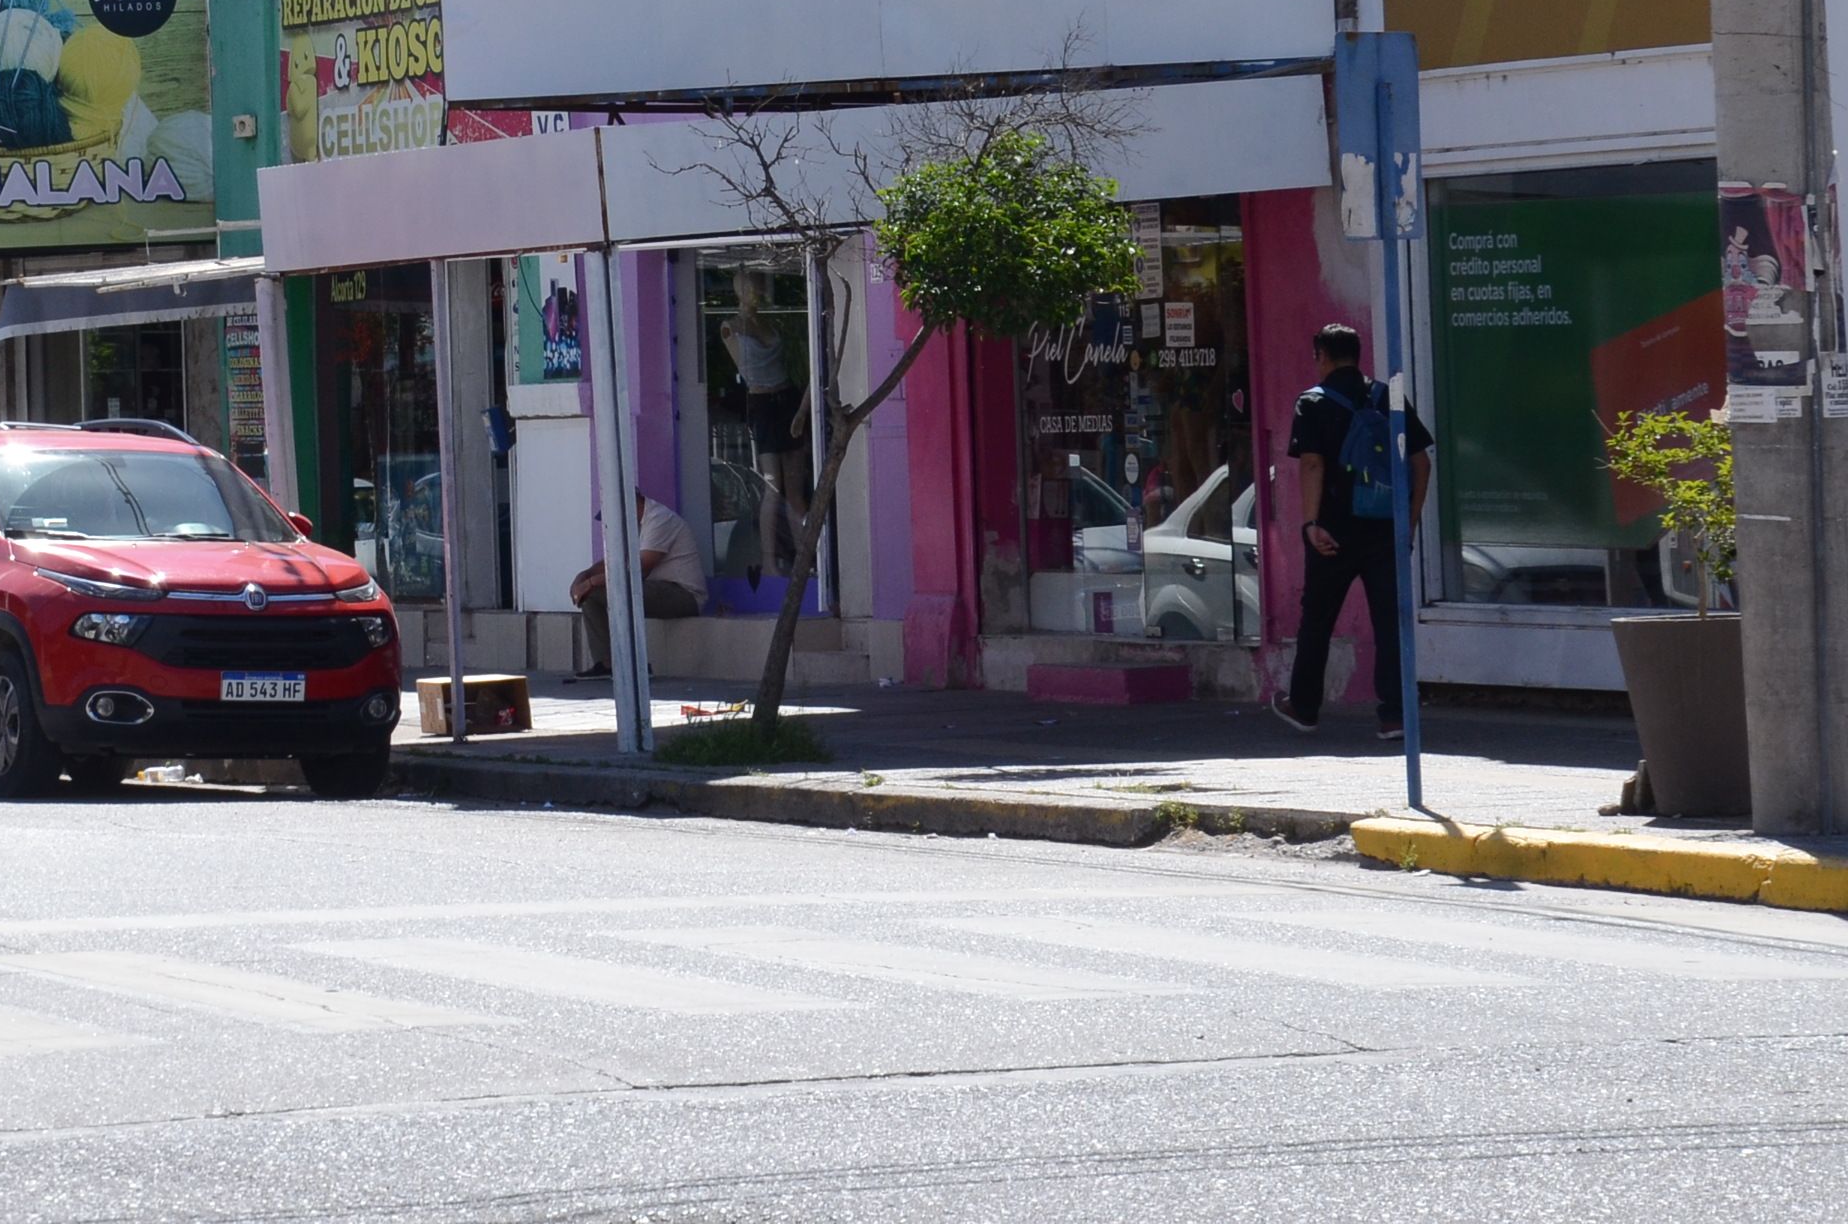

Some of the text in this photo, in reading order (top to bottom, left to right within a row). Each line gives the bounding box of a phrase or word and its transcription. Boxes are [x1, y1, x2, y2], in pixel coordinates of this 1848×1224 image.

[103, 2, 162, 12] HILADOS
[335, 35, 351, 89] &
[1449, 230, 1518, 253] Comprá con
[1450, 255, 1542, 278] crédito personal
[1451, 281, 1552, 303] en cuotas fijas, en
[1452, 306, 1572, 327] comercios adheridos.
[1027, 321, 1065, 383] Piel
[1159, 350, 1176, 368] 299
[1040, 415, 1113, 433] CASA DE MEDIAS
[225, 681, 302, 698] AD 543 HF
